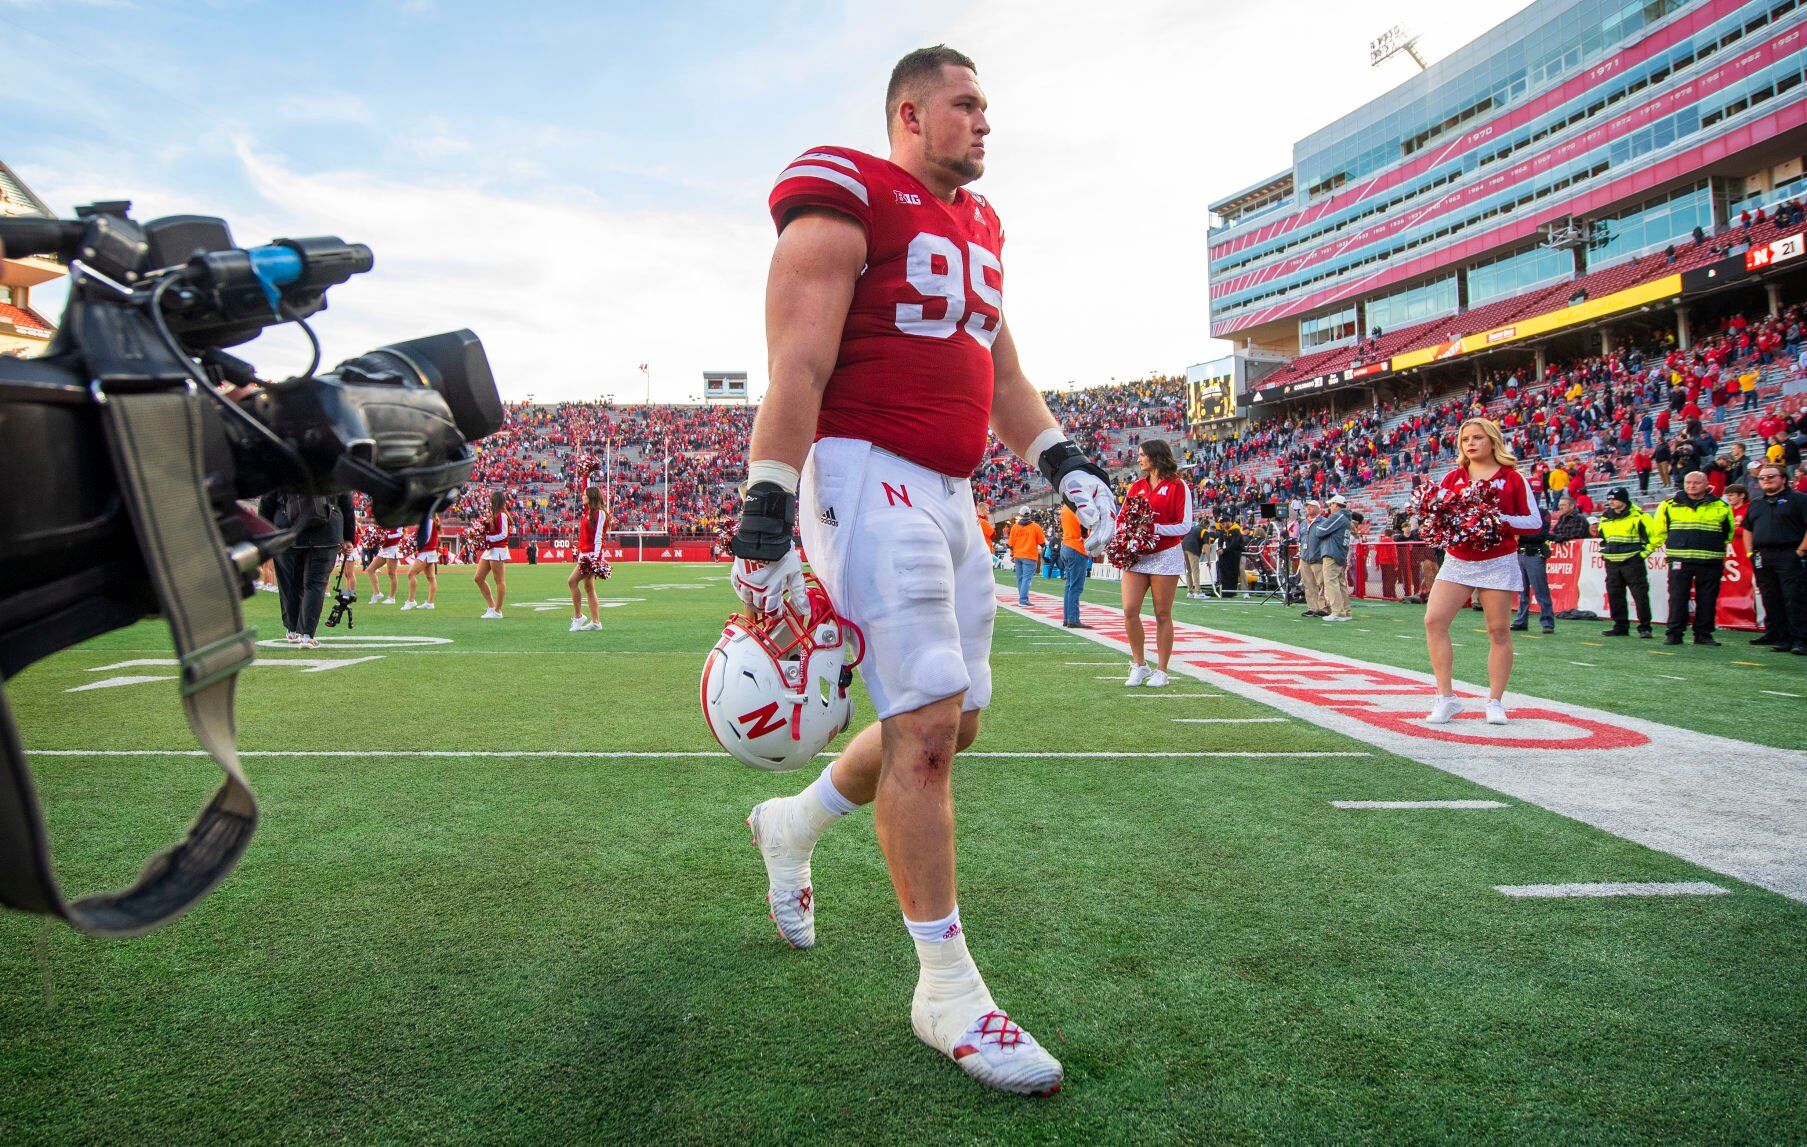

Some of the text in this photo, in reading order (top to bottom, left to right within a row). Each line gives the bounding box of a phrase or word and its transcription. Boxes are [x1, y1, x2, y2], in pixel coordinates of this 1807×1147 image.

[1735, 51, 1761, 69] 1982
[1772, 31, 1800, 50] 1983
[1467, 58, 1620, 144] 1970 1971
[1782, 241, 1795, 256] 21
[895, 231, 1003, 353] 95
[881, 481, 912, 507] N
[554, 540, 570, 548] 0:00
[1549, 540, 1576, 559] EAST
[556, 550, 564, 558] N
[615, 549, 623, 558] N
[674, 549, 682, 558] N
[1545, 562, 1574, 574] CHAPTER
[737, 701, 788, 740] N
